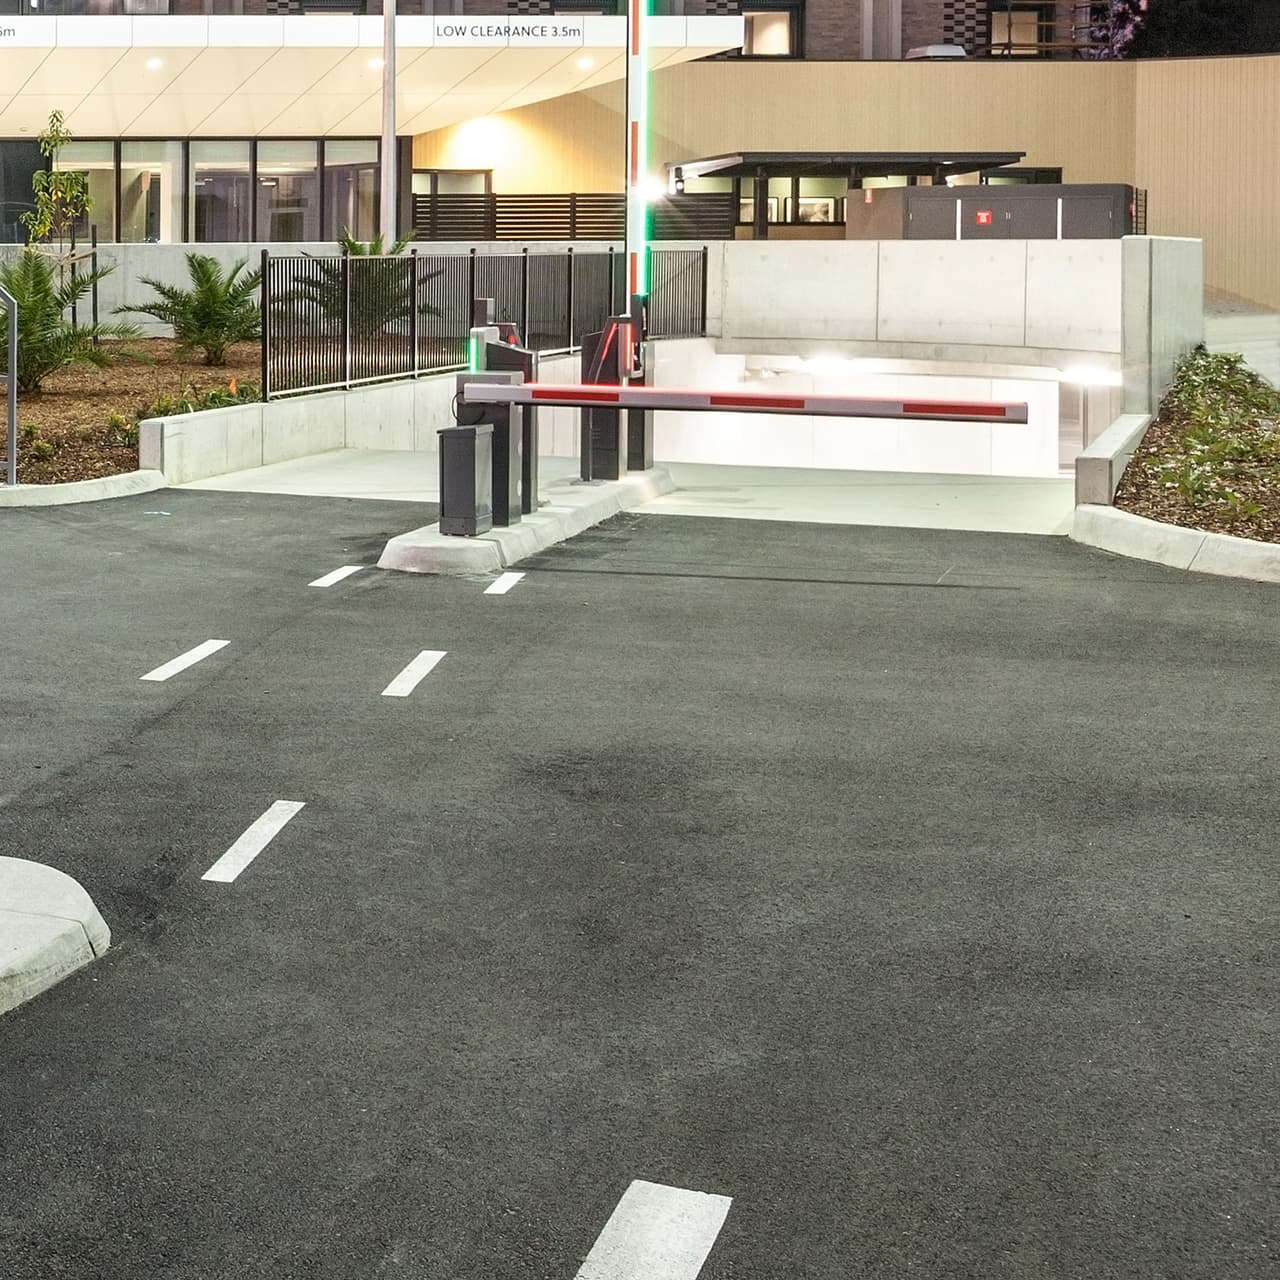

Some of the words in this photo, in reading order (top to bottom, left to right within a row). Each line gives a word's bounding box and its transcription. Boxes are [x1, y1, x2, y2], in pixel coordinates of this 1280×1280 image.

[436, 25, 467, 37] LOW
[470, 25, 548, 37] CLEARANCE
[551, 25, 581, 37] 3.5m
